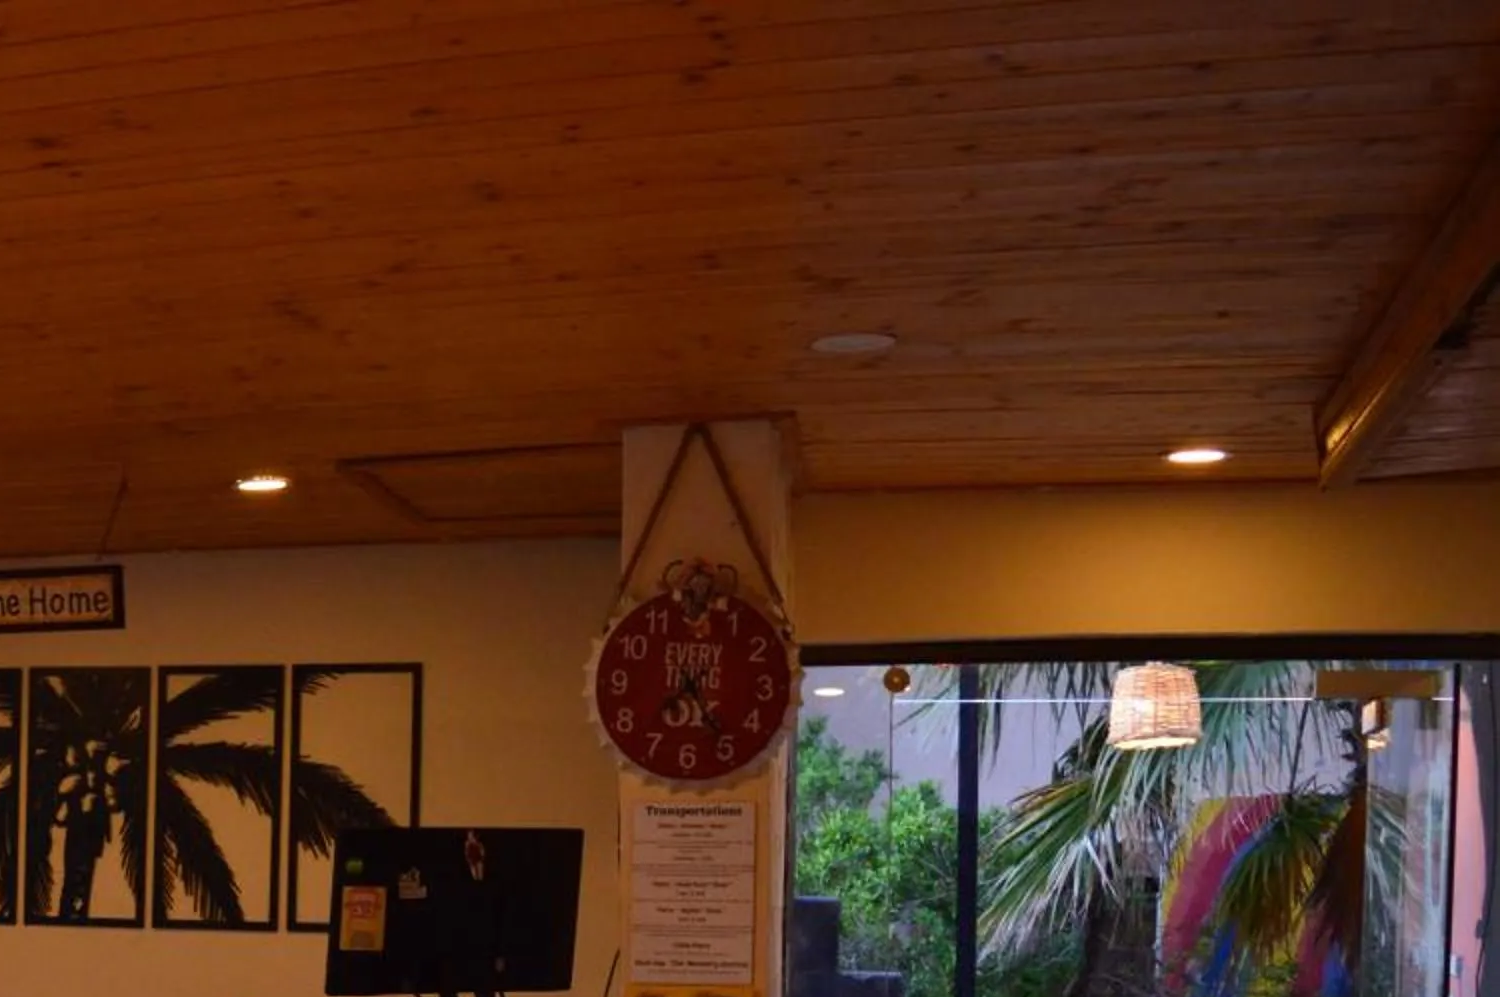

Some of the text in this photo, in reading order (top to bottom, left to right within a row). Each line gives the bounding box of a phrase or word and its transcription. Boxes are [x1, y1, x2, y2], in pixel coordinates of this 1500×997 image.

[29, 586, 111, 616] Home
[645, 608, 669, 634] 11
[728, 611, 739, 637] 1
[619, 634, 648, 660] 10
[665, 641, 723, 665] EVERY
[748, 636, 768, 662] 2
[611, 669, 629, 695] 9
[756, 674, 774, 701] 3
[616, 708, 634, 733] 8
[742, 708, 760, 733] 4
[645, 733, 664, 759] 7
[678, 744, 696, 770] 6
[716, 735, 734, 761] 5
